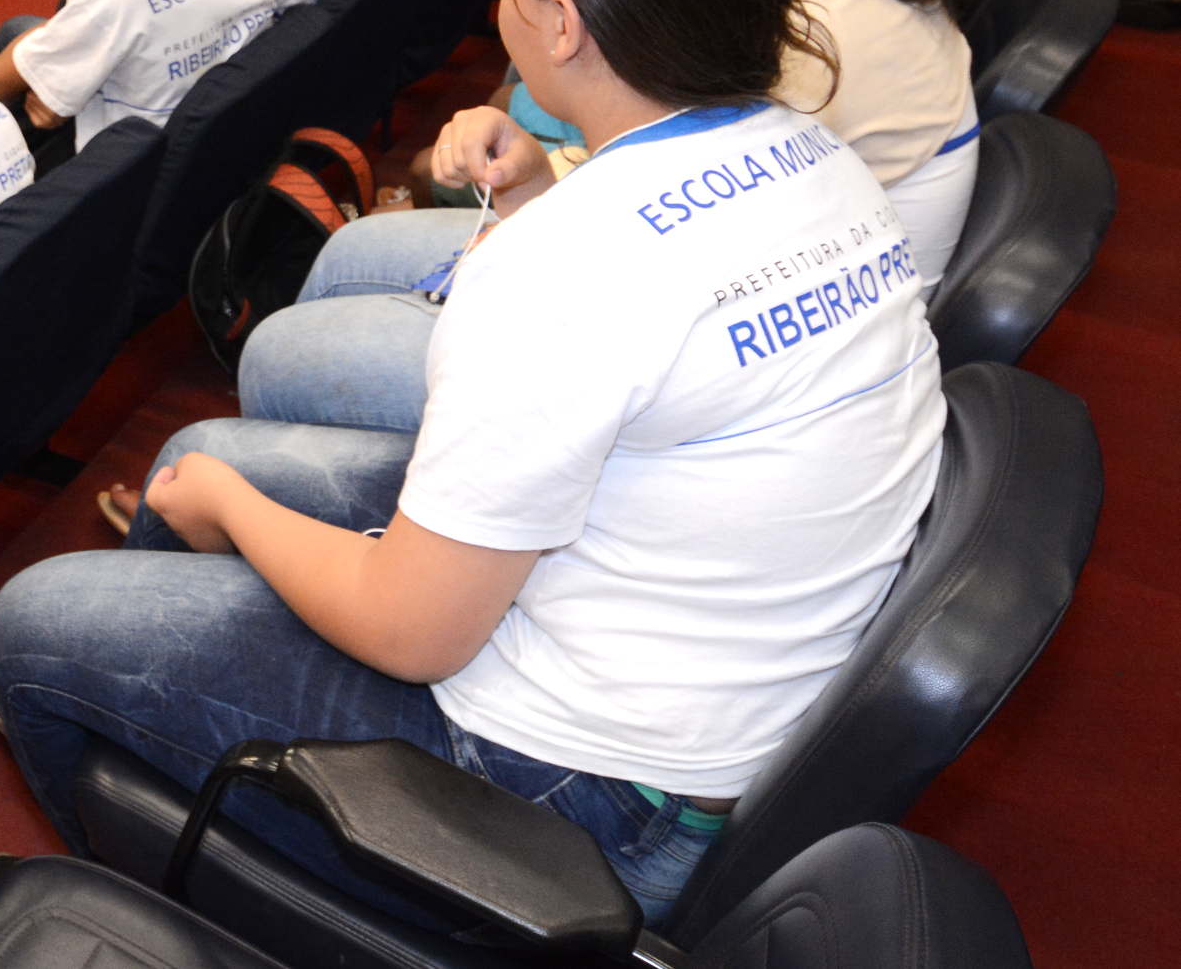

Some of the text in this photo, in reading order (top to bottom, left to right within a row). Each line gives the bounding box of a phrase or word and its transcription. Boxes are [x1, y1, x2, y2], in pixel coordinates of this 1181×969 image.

[637, 154, 776, 235] ESCOLA
[713, 238, 844, 308] PREFEITURA
[848, 222, 873, 247] DA
[727, 265, 879, 367] RIBEIRÃO
